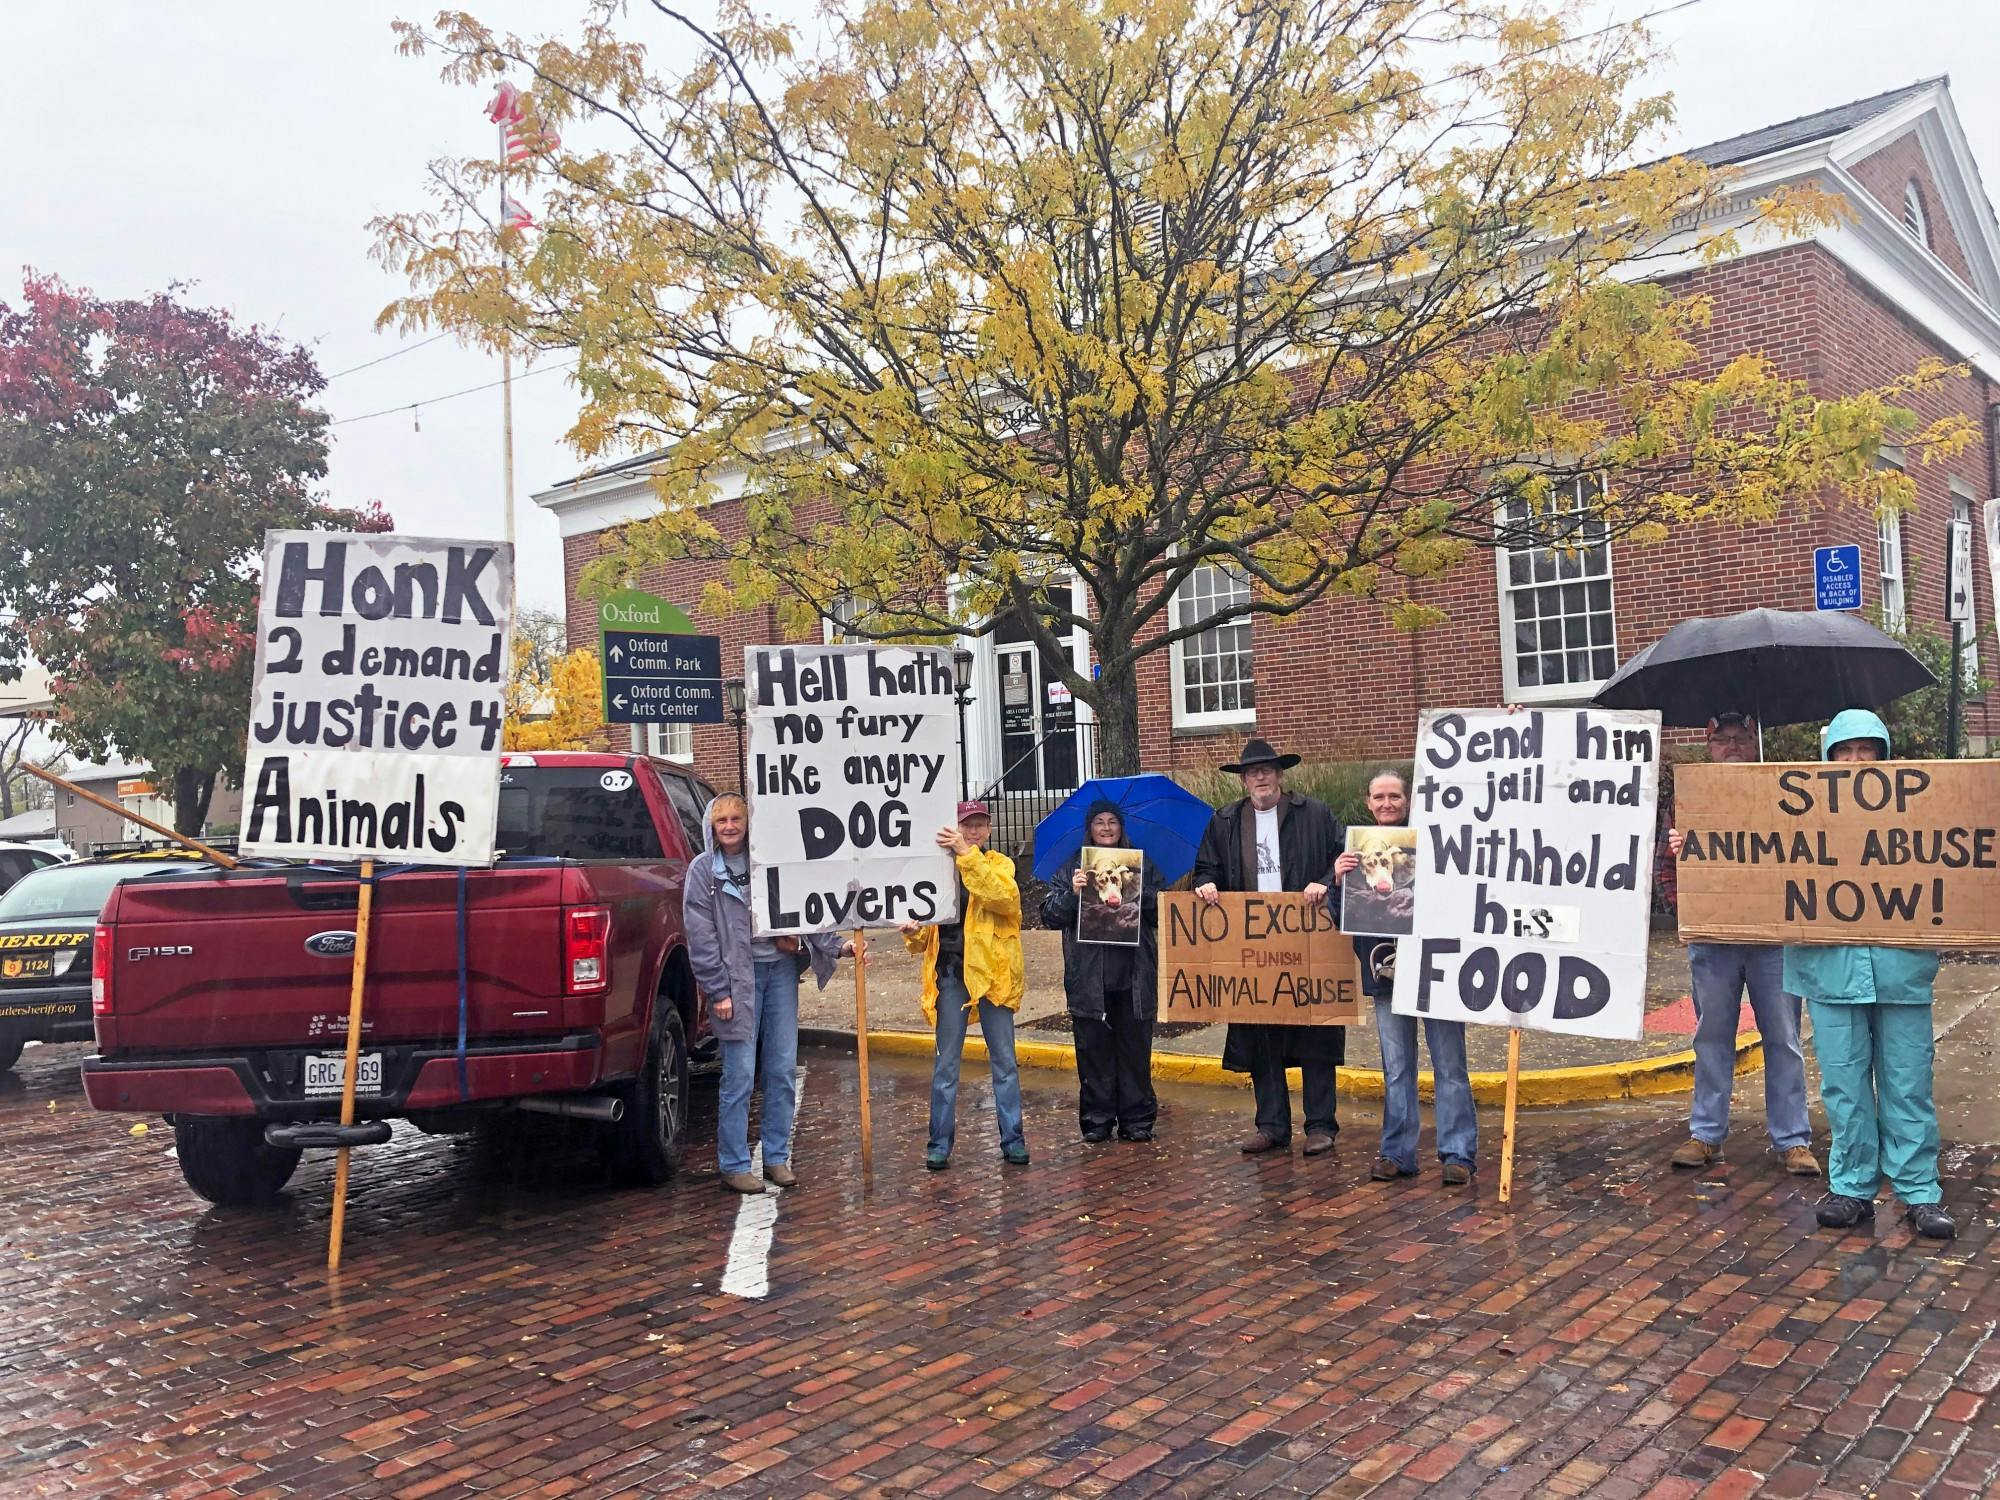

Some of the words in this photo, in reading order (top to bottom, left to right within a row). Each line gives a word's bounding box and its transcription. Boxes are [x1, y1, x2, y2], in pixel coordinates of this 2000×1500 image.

[1822, 574, 1854, 583] DISABLED
[1825, 582, 1852, 590] ACCESS
[1828, 590, 1847, 598] BACK
[602, 602, 660, 624] Oxford
[1823, 597, 1854, 606] BUILDING
[266, 626, 303, 674] 2
[321, 623, 502, 683] demand
[628, 638, 668, 653] Oxford
[629, 656, 671, 671] Comm.
[675, 657, 702, 671] Park
[631, 684, 670, 699] Oxford
[675, 685, 715, 699] Comm.
[756, 649, 847, 707] Hell
[867, 650, 953, 697] hath
[254, 683, 457, 750] justice
[469, 700, 502, 750] 4
[632, 702, 656, 716] Arts
[660, 702, 699, 716] Center
[773, 713, 823, 745] no
[836, 705, 924, 743] fury
[1426, 711, 1544, 769] Send
[1576, 711, 1653, 763] him
[603, 776, 629, 787] 0.7
[843, 753, 945, 798] angry
[1417, 775, 1463, 812] to
[1473, 764, 1544, 822] jail
[1568, 765, 1641, 807] and
[1778, 767, 1931, 816] STOP
[246, 756, 465, 853] Animals
[798, 800, 911, 860] DOG
[1680, 829, 1838, 866] ANIMAL
[1860, 827, 1997, 868] ABUSE
[1428, 823, 1640, 891] Withhold
[766, 866, 937, 930] Lovers
[1473, 883, 1554, 938] his
[1785, 878, 1944, 926] NOW!
[1170, 902, 1229, 946] NO
[1245, 900, 1339, 940] EXCUS
[318, 936, 354, 951] Ford
[1241, 948, 1302, 968] PUNISH
[9, 964, 16, 972] 9
[25, 960, 49, 971] 1124
[1416, 938, 1611, 1020] FOOD
[1168, 969, 1268, 1008] ANIMAL
[1272, 972, 1354, 1008] ABUSE
[308, 1063, 337, 1083] GRG
[342, 1060, 379, 1081] 69
